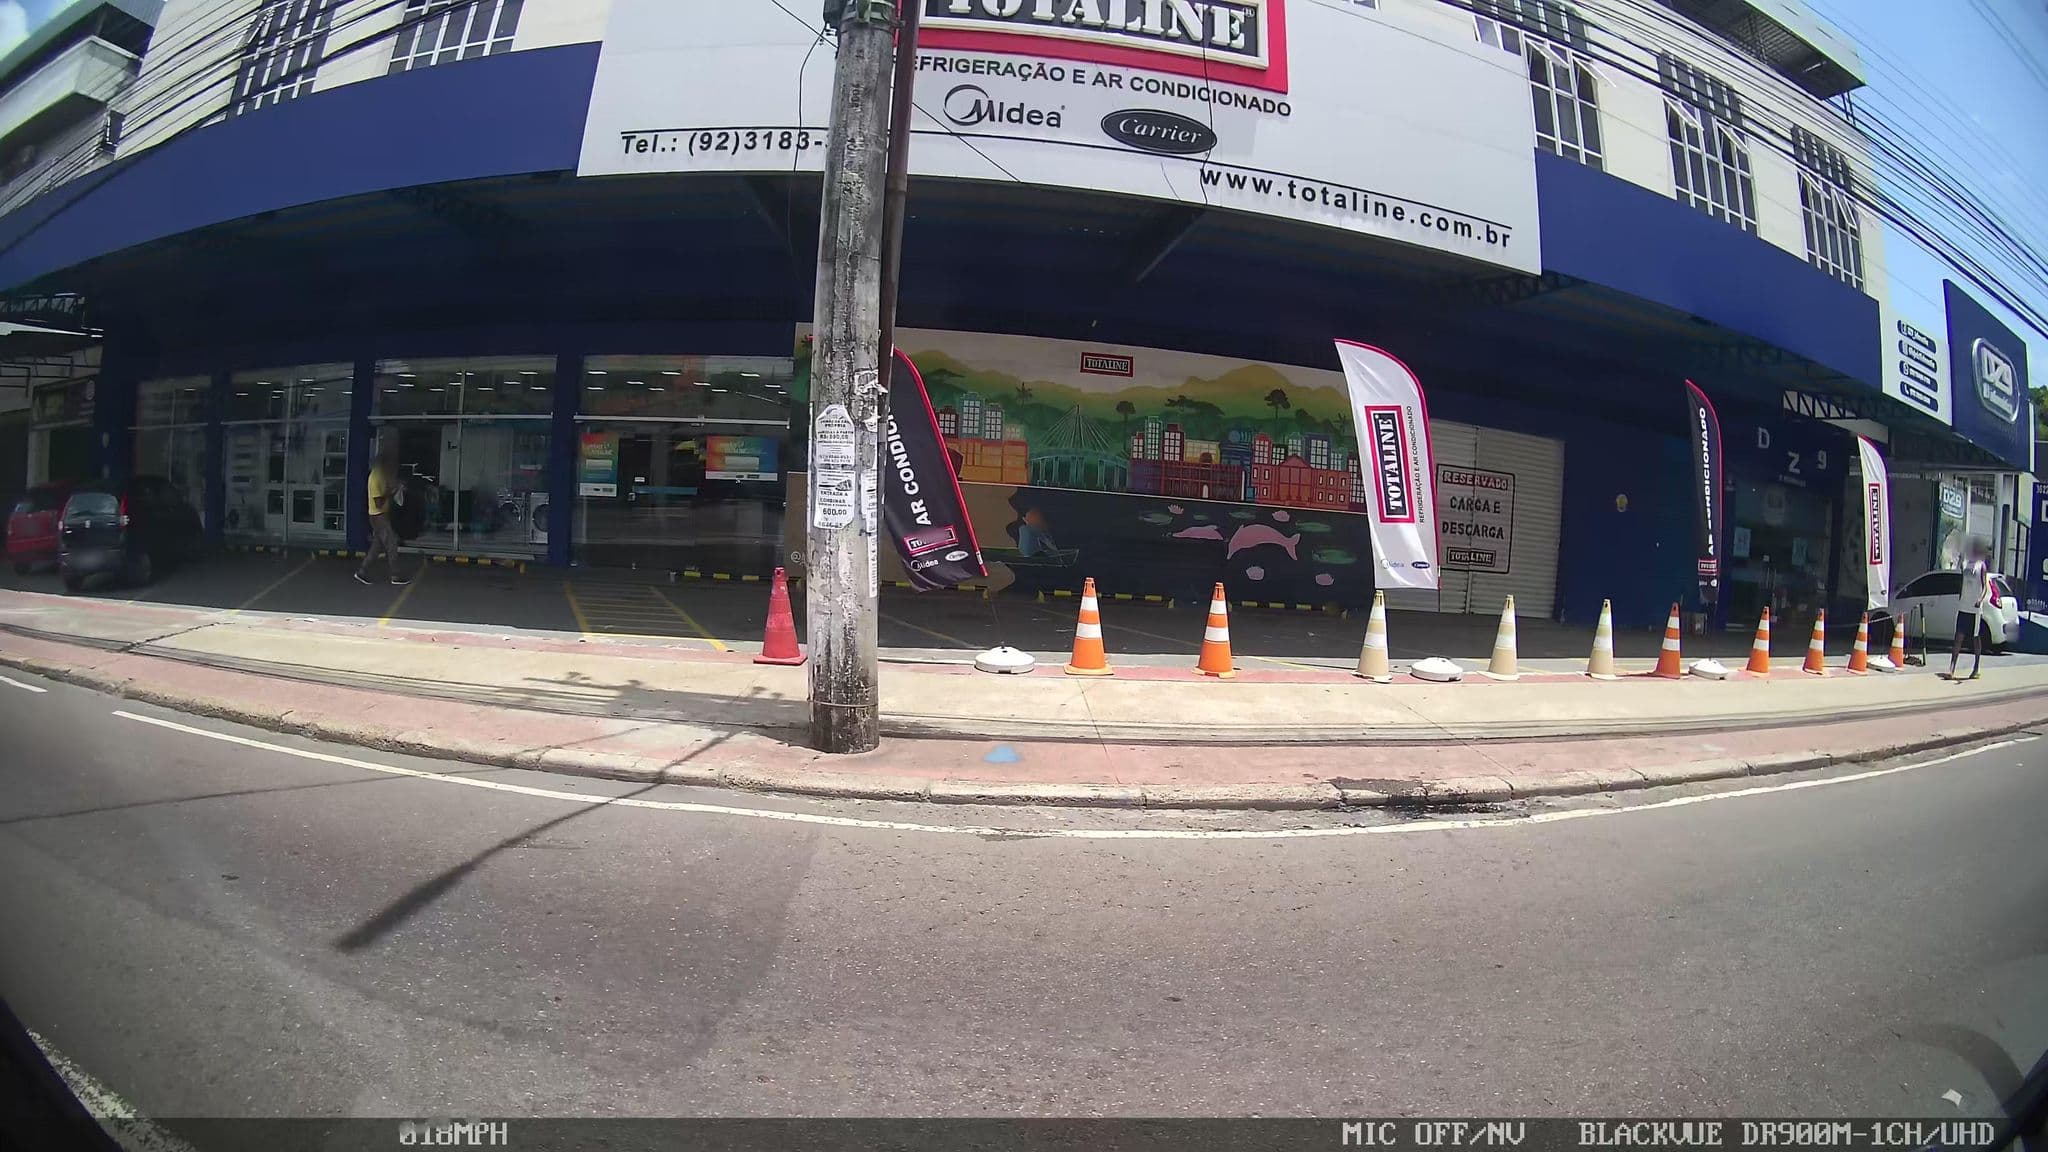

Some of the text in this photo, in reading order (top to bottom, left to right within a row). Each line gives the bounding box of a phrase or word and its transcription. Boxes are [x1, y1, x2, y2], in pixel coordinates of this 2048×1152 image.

[893, 55, 1291, 117] FRIGERAÇÃO E AR CONDICIONADO
[943, 84, 1062, 128] Midea
[621, 134, 677, 154] Tel.:
[688, 131, 829, 155] (92)3183-
[1119, 118, 1202, 144] Carrier
[1201, 167, 1512, 248] www.totaline.com.br
[1086, 358, 1128, 371] TOTALINE
[887, 405, 931, 525] AR CONDIC
[1379, 419, 1403, 511] TOTALINE
[1443, 471, 1508, 490] RESERVADO
[1450, 496, 1501, 513] CARGA E
[1442, 521, 1504, 540] DESCARGA
[1450, 551, 1493, 562] TOTALINE
